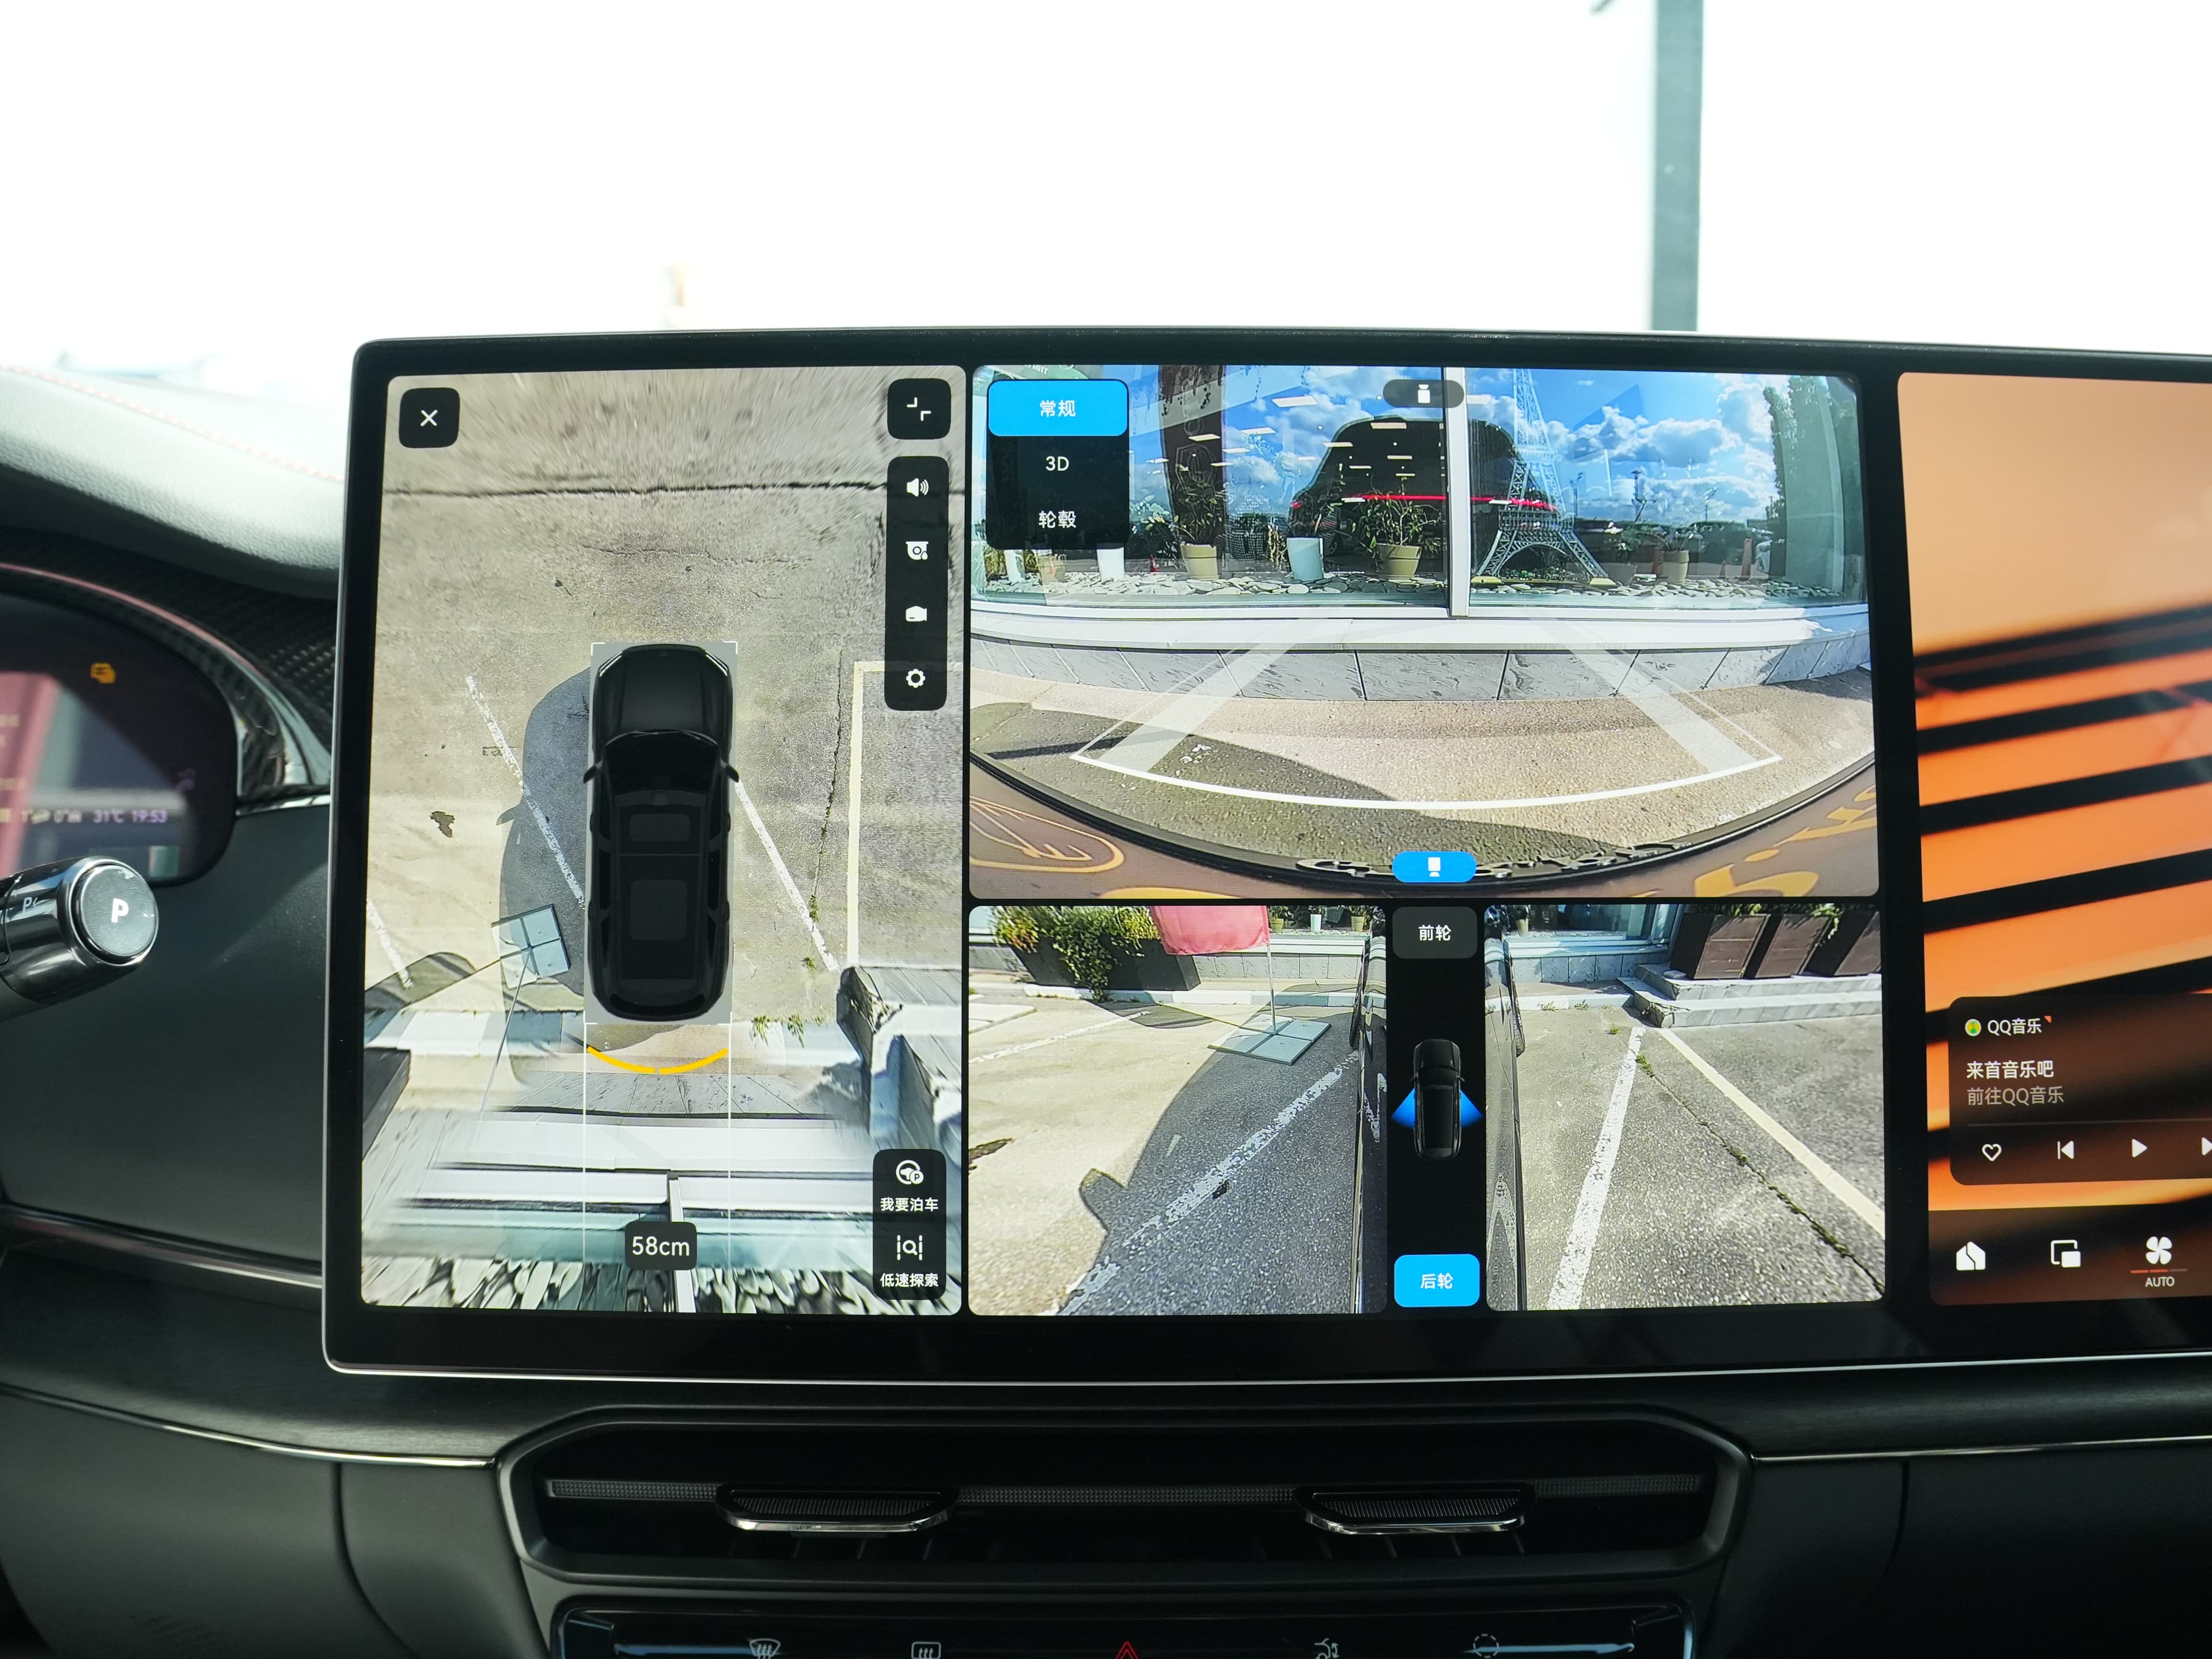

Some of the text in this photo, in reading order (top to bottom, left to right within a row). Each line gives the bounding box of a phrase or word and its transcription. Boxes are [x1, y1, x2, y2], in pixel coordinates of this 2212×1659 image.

[1039, 400, 1076, 417] 常规
[1046, 456, 1070, 472] 3D
[1038, 510, 1077, 529] 轮毂
[111, 897, 129, 923] P
[1418, 925, 1451, 941] 前轮
[1987, 1018, 2042, 1036] QQ音乐
[1966, 1060, 2054, 1080] 来首音乐吧
[1967, 1085, 2065, 1107] 前往QQ音乐
[880, 1196, 939, 1213] 我要泊车
[632, 1236, 690, 1256] 58cm
[880, 1272, 939, 1288] 低速探索
[1420, 1272, 1453, 1290] 后轮
[2145, 1277, 2175, 1287] AUTO
